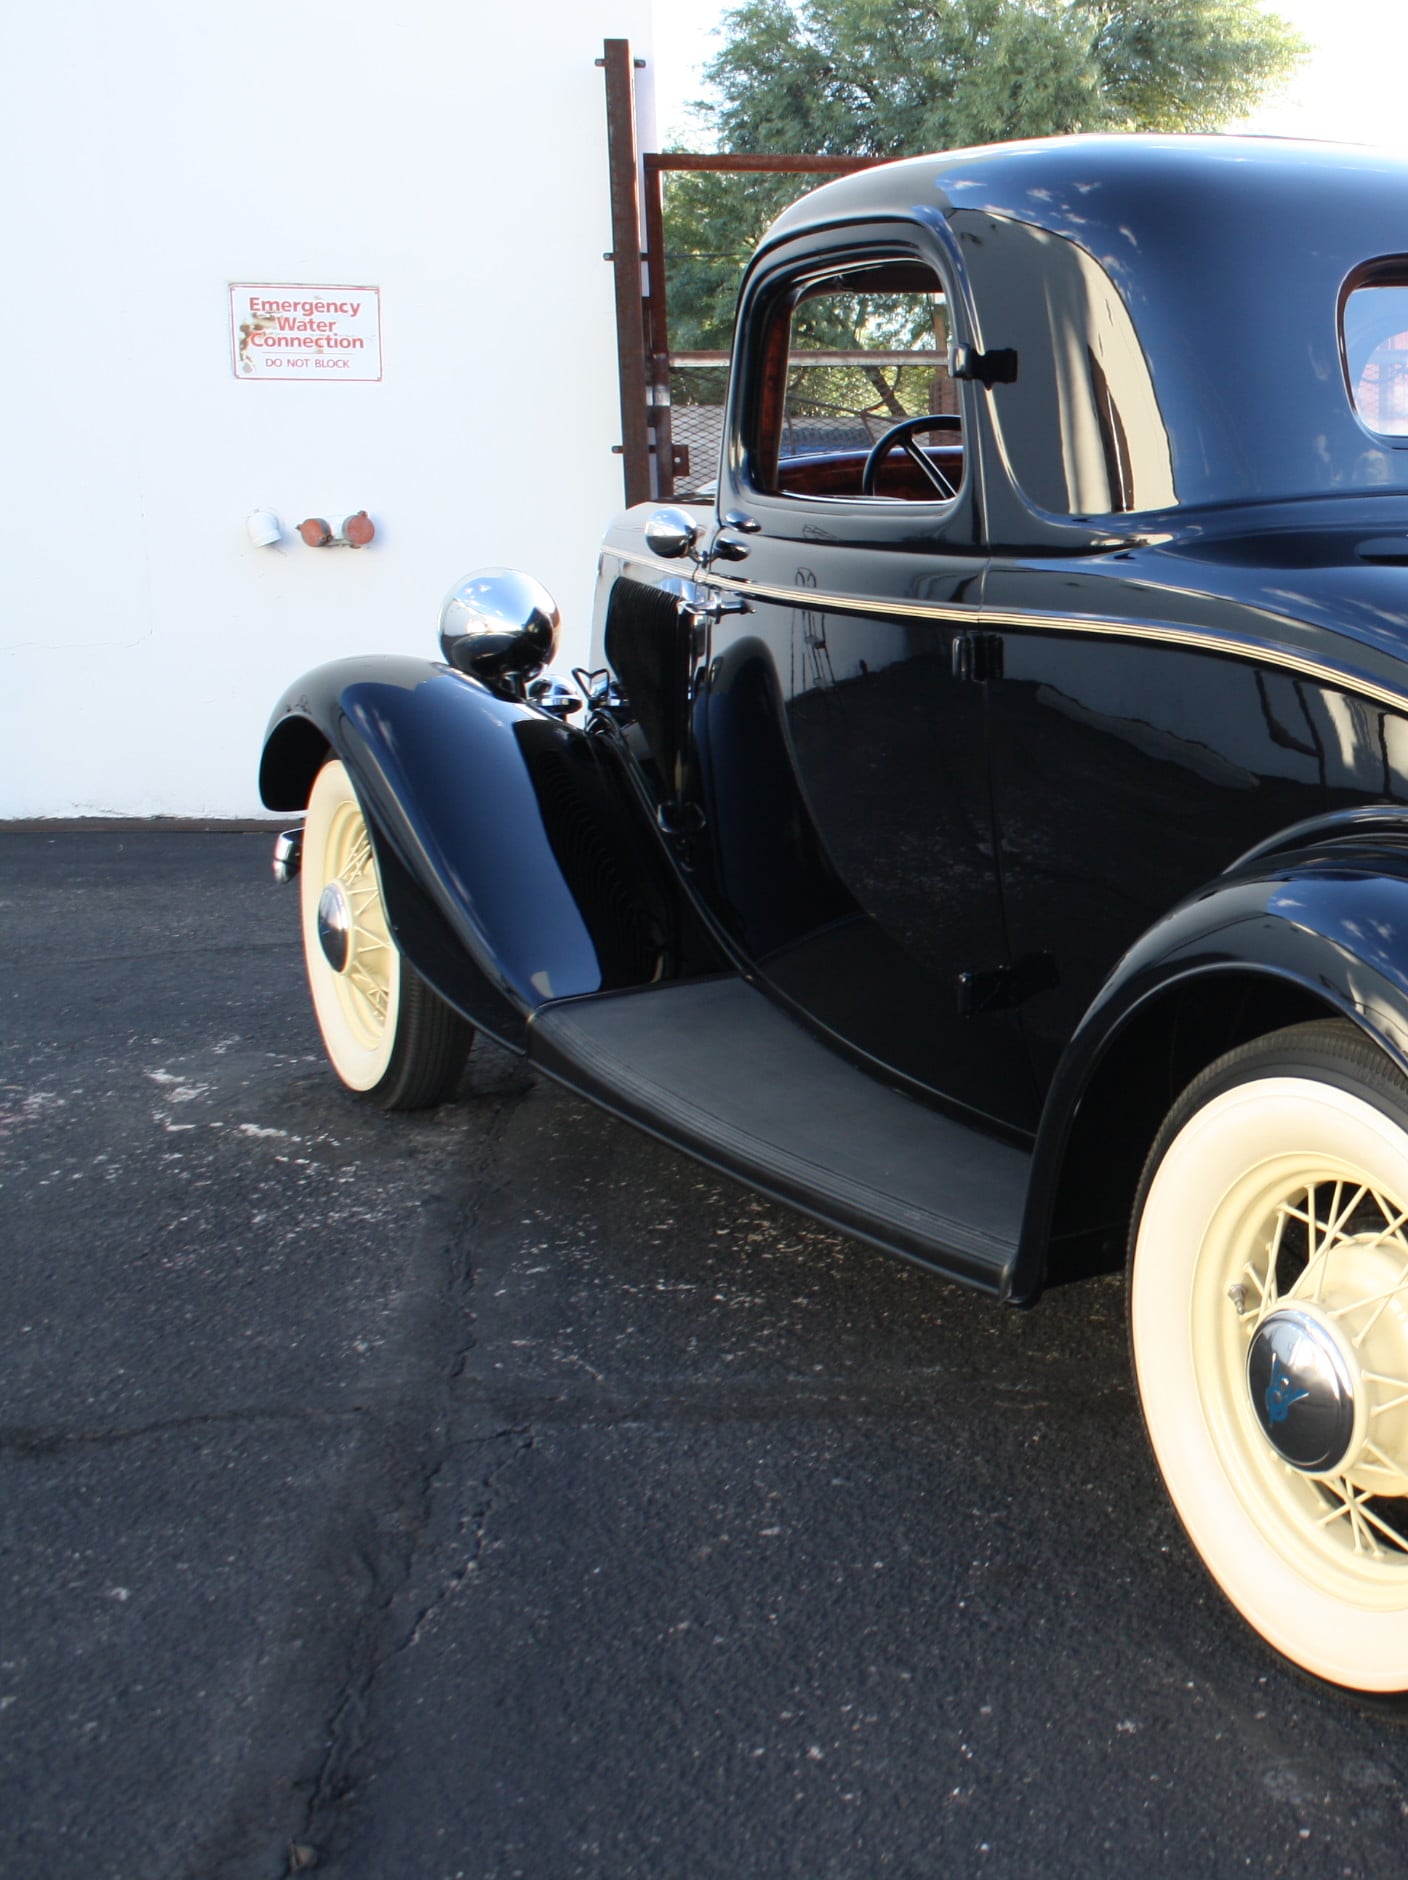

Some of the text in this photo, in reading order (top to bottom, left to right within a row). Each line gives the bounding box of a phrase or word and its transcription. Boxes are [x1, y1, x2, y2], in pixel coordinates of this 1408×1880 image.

[249, 297, 361, 317] Emergency
[275, 316, 337, 332] Water
[249, 332, 365, 349] Connection
[265, 358, 351, 369] DO NOT BLOCK
